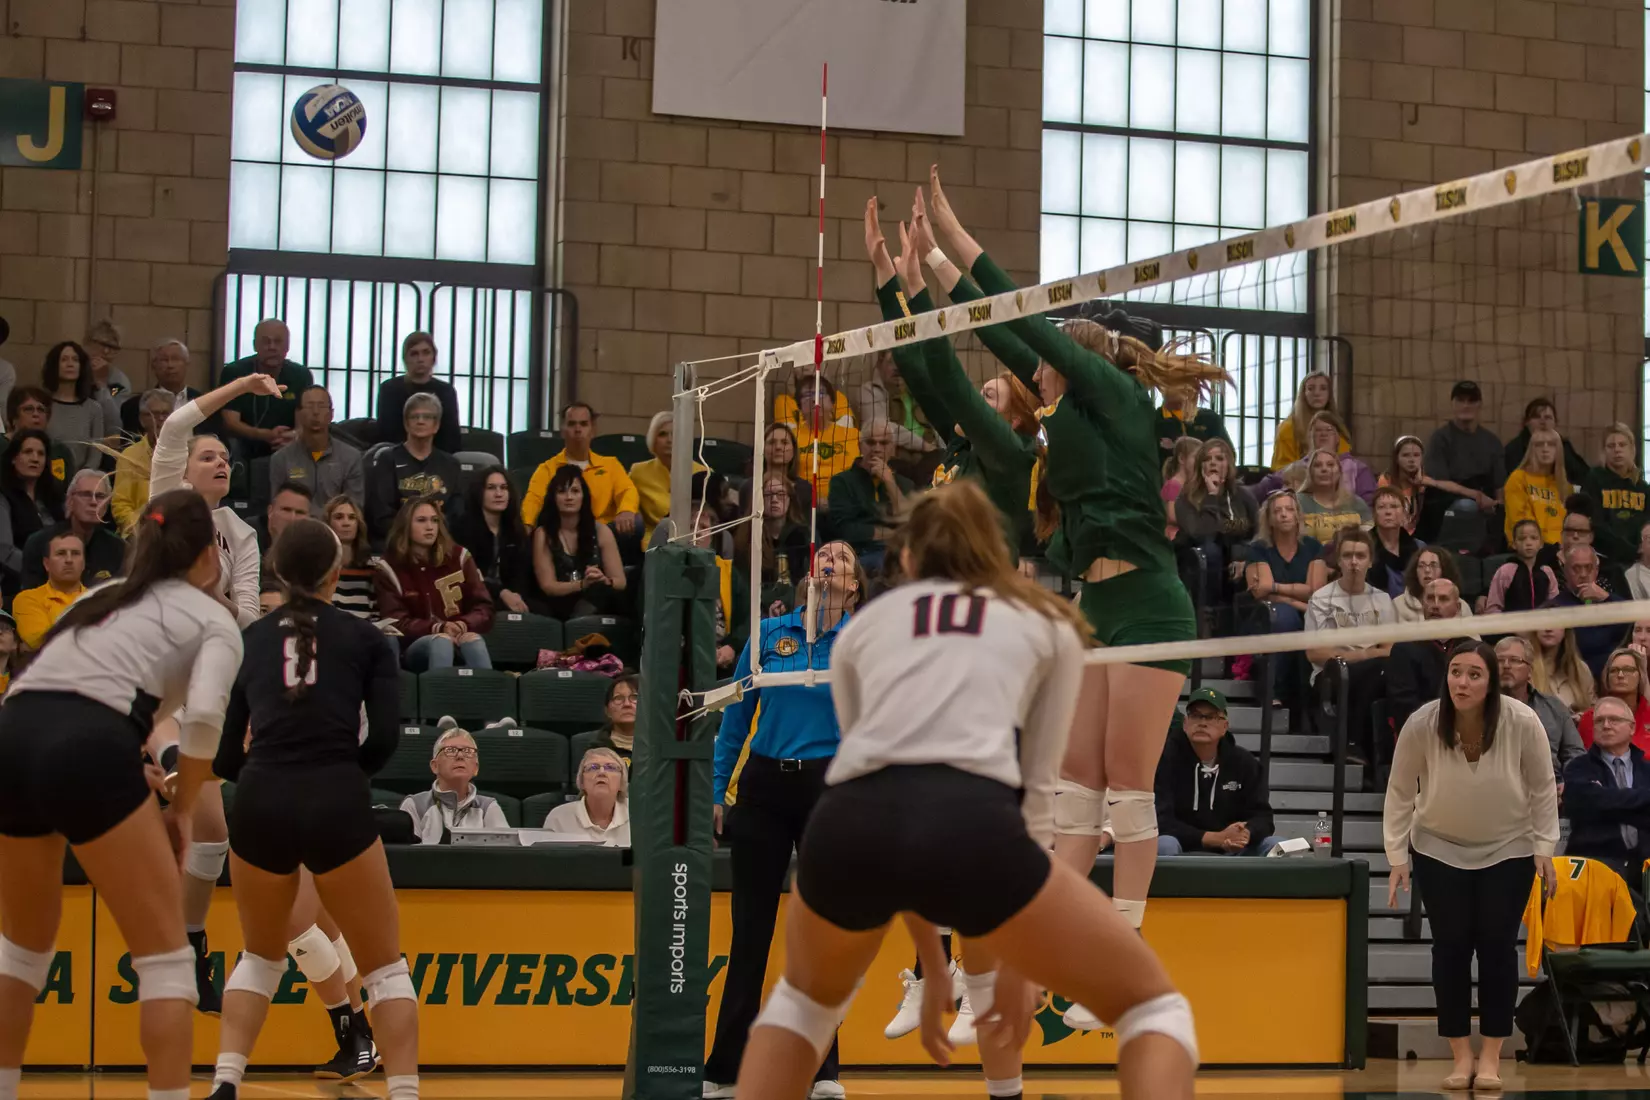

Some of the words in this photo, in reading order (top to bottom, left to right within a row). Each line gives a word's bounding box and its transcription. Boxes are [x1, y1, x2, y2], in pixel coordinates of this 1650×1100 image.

[16, 86, 66, 162] J
[330, 105, 363, 130] molten
[1585, 201, 1638, 272] K
[434, 570, 465, 618] F
[912, 593, 988, 637] 10
[671, 863, 689, 920] sports
[1569, 858, 1587, 880] 7
[647, 1065, 696, 1074] (800)556-3198
